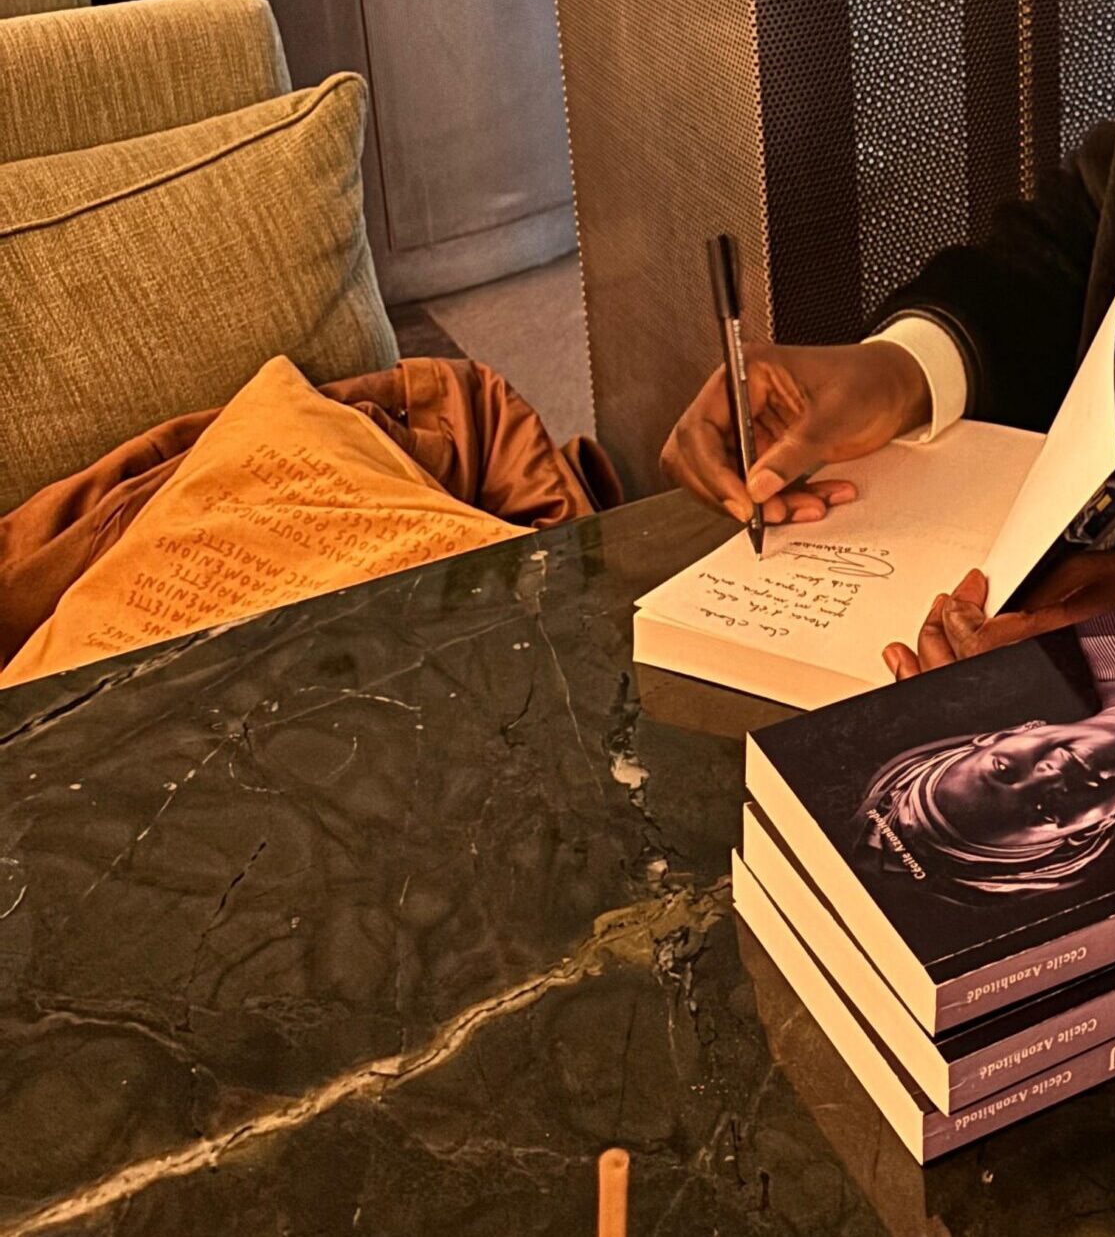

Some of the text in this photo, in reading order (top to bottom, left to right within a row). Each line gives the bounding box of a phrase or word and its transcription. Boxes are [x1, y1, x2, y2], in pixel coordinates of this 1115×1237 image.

[270, 522, 312, 548] TOUT
[155, 536, 278, 596] PROMENIONS
[1046, 946, 1088, 970] Cécile
[1058, 1018, 1098, 1043] Cécile
[1032, 1070, 1072, 1095] Cécile
